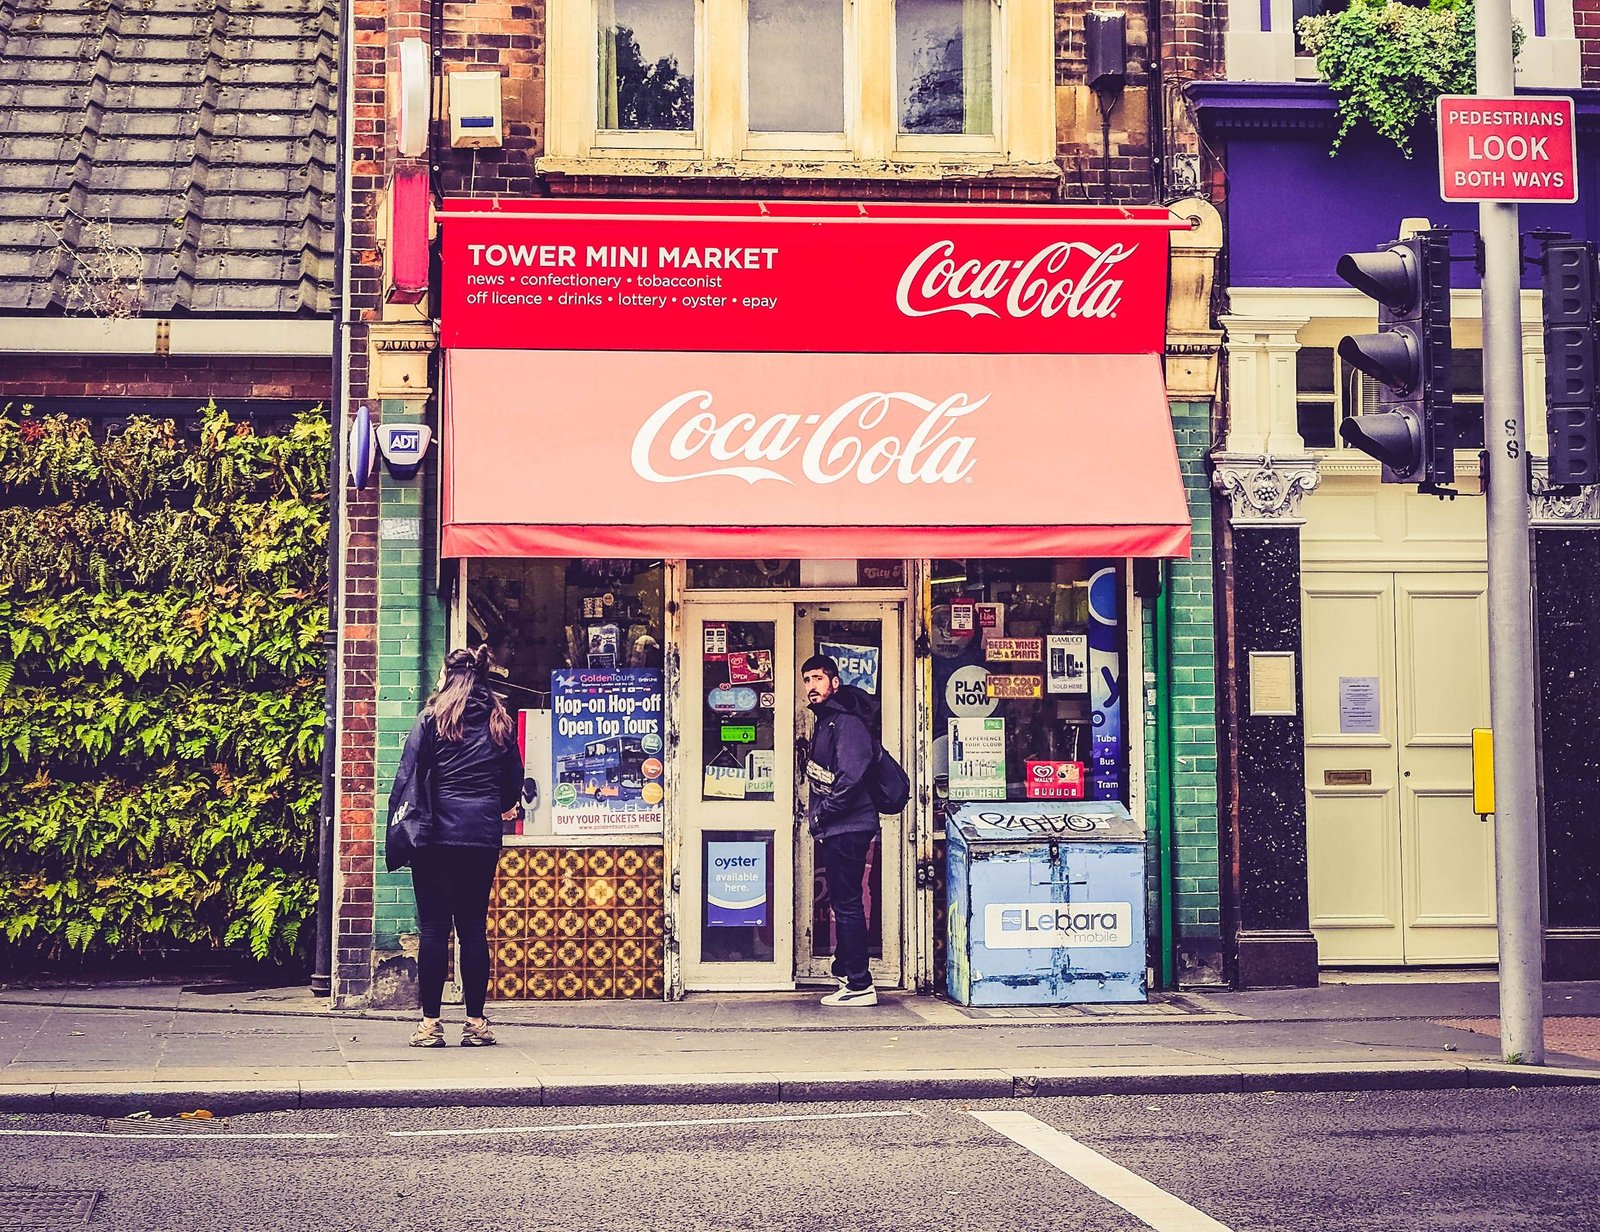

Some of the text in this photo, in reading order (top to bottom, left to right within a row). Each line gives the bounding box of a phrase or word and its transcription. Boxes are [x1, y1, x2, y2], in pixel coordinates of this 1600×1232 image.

[1449, 111, 1564, 127] PEDESTRIANS
[1468, 135, 1550, 161] LOOK
[1455, 170, 1565, 188] BOTH WAYS
[467, 244, 779, 270] TOWER MINI MARKET
[467, 273, 723, 289] news confectionery tobacconist
[895, 239, 1140, 319] Coca-Cola
[466, 292, 778, 310] off licence drinks lottery oyster epay
[390, 434, 419, 450] ADT
[630, 389, 993, 486] Coca-Cola
[1014, 640, 1040, 649] WINES
[1051, 636, 1083, 644] GAMUCCI
[1010, 650, 1040, 659] SPIRITS
[580, 673, 635, 683] GoldenTours
[988, 676, 1041, 687] ICED COLD
[993, 686, 1035, 696] DRINKS
[554, 693, 662, 717] Hop-on Hop-off
[955, 693, 991, 706] NOW
[558, 715, 659, 738] Open Top Tours
[1096, 734, 1117, 743] Tube
[1099, 757, 1115, 766] Bus
[706, 765, 746, 780] open
[1096, 780, 1119, 789] Tram
[949, 788, 1006, 799] SOLD HERE
[556, 813, 661, 825] BUY YOUR TICKETS HERE
[714, 855, 758, 870] oyster
[715, 872, 759, 882] available
[725, 883, 750, 893] here.
[1024, 909, 1118, 931] Lebara
[1073, 931, 1118, 943] mobile
